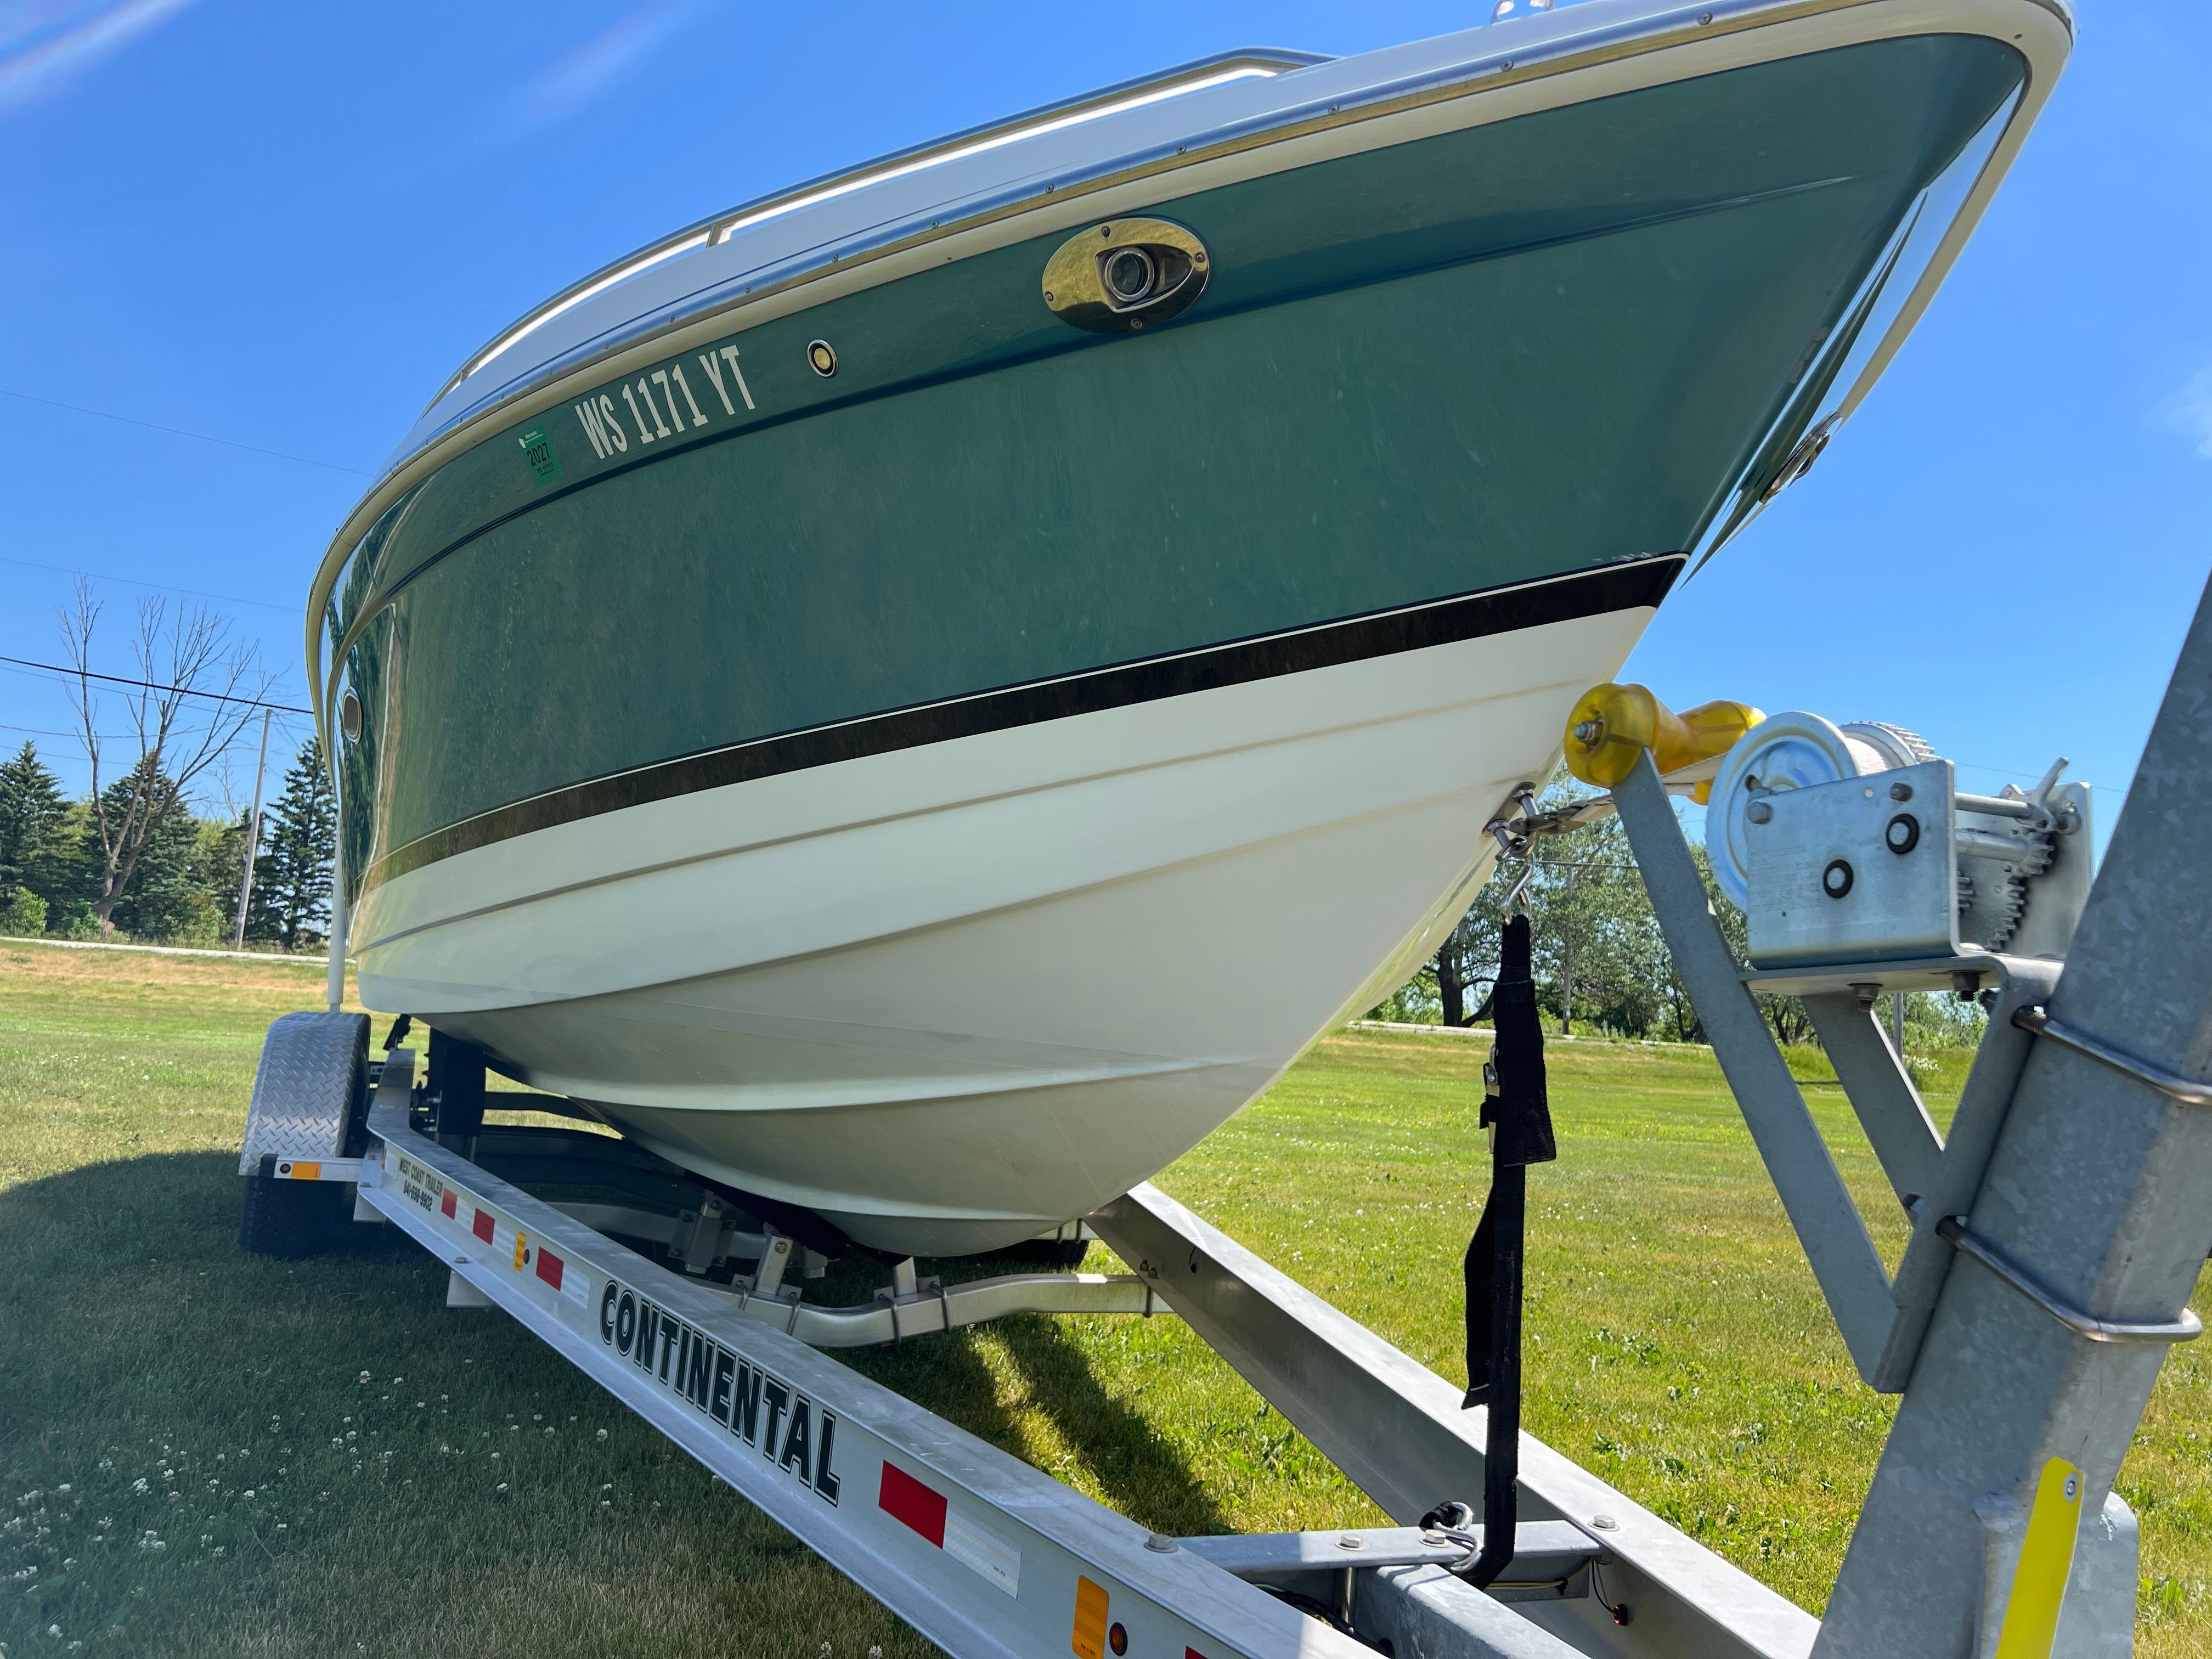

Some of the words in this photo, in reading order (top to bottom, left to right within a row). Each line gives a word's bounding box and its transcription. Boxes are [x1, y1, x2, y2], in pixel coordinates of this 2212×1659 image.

[575, 394, 627, 459] WS
[622, 364, 708, 444] 1171
[698, 345, 755, 415] YT
[527, 442, 550, 467] 2027
[399, 1156, 411, 1177] WEST
[411, 1164, 425, 1185] COAST
[425, 1172, 443, 1198] TRAILER
[600, 1280, 840, 1508] CONTINENTAL
